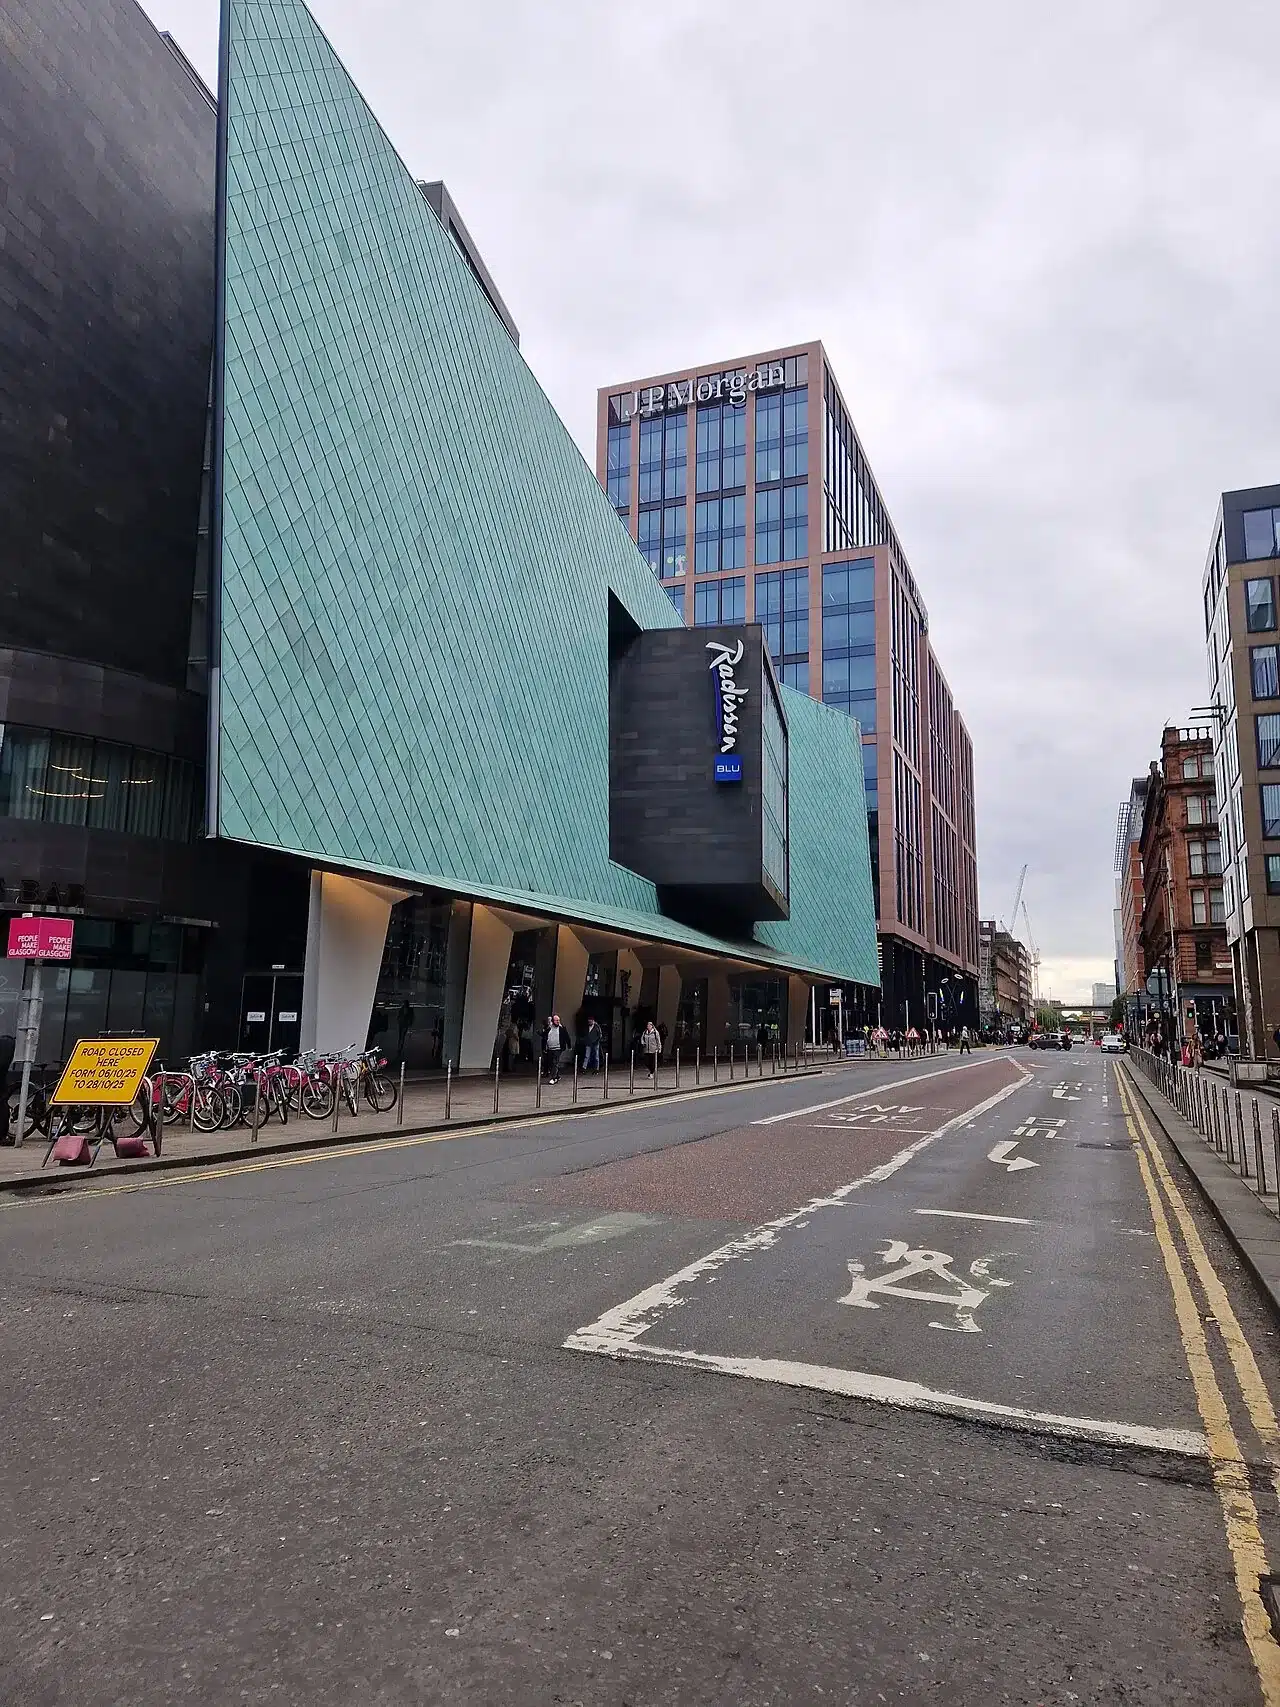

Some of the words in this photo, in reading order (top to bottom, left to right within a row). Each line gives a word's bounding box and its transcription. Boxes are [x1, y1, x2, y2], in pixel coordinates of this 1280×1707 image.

[705, 638, 749, 753] Radisson
[716, 764, 740, 773] BLU
[49, 936, 72, 944] PEOPLE
[8, 948, 37, 956] GLASGOW
[38, 950, 70, 958] GLASGOW
[81, 1047, 106, 1056] ROAD
[108, 1047, 144, 1056] CLOSED
[70, 1069, 96, 1078] FORM
[98, 1069, 137, 1079] 06/10/25
[73, 1080, 86, 1089] TO
[86, 1080, 125, 1090] 28/10/25
